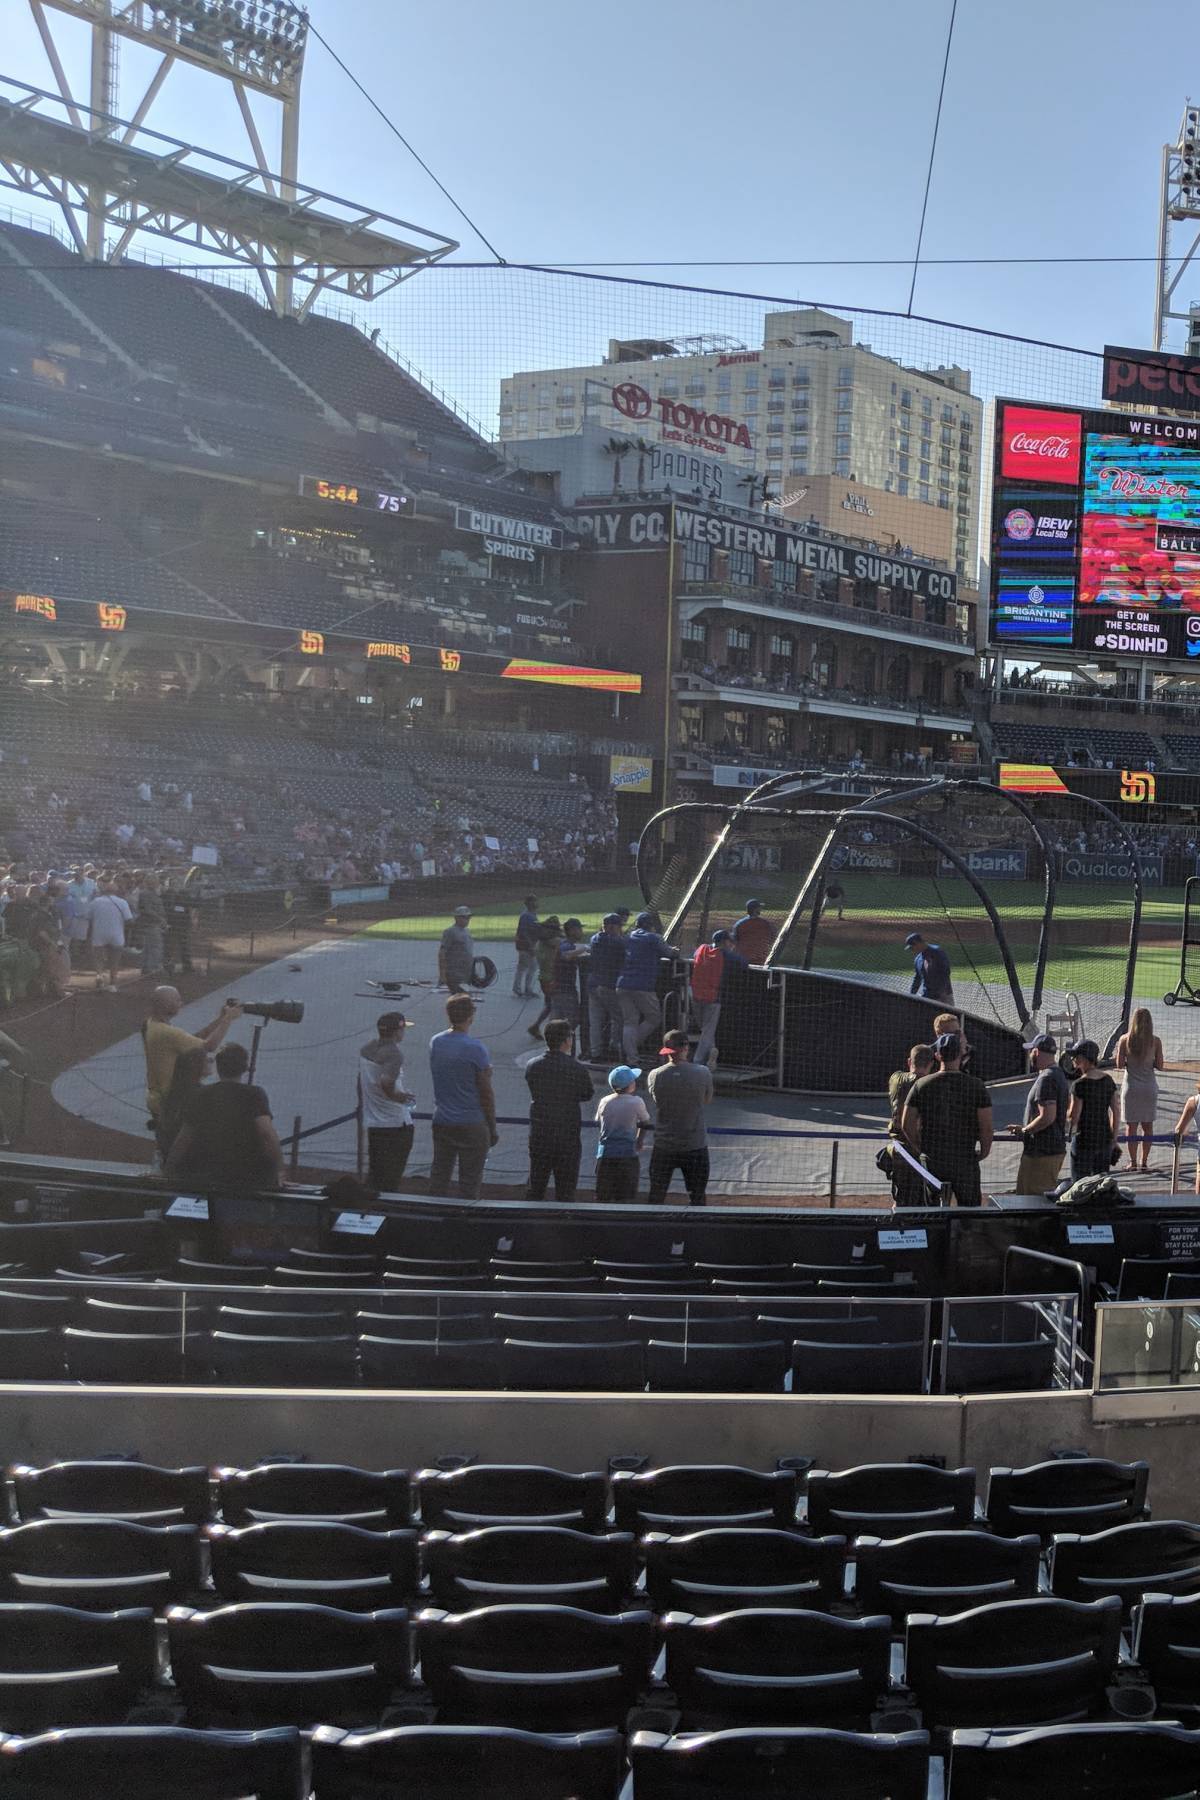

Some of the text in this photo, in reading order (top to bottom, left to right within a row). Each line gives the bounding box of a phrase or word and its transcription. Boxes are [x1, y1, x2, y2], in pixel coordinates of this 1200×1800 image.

[657, 397, 752, 449] TOYOTA
[1010, 433, 1072, 458] Coca-Cola
[651, 450, 722, 499] PADRES
[1101, 467, 1189, 498] Mister
[317, 481, 358, 504] 5:44
[377, 494, 407, 512] 75°
[470, 511, 552, 546] CUTWATER
[1036, 529, 1054, 538] Local
[1037, 517, 1072, 531] IBEW
[484, 538, 535, 562] SPIRITS
[674, 509, 955, 599] WESTERN METAL SUPPLY CO.
[16, 595, 57, 620] PADRES
[1004, 606, 1067, 619] BRIGANTINE
[1117, 610, 1149, 621] GET ON
[1105, 620, 1160, 633] THE SCREEN
[367, 643, 410, 664] PADRES
[613, 766, 650, 785] Snapple
[849, 857, 894, 868] LEAGUE
